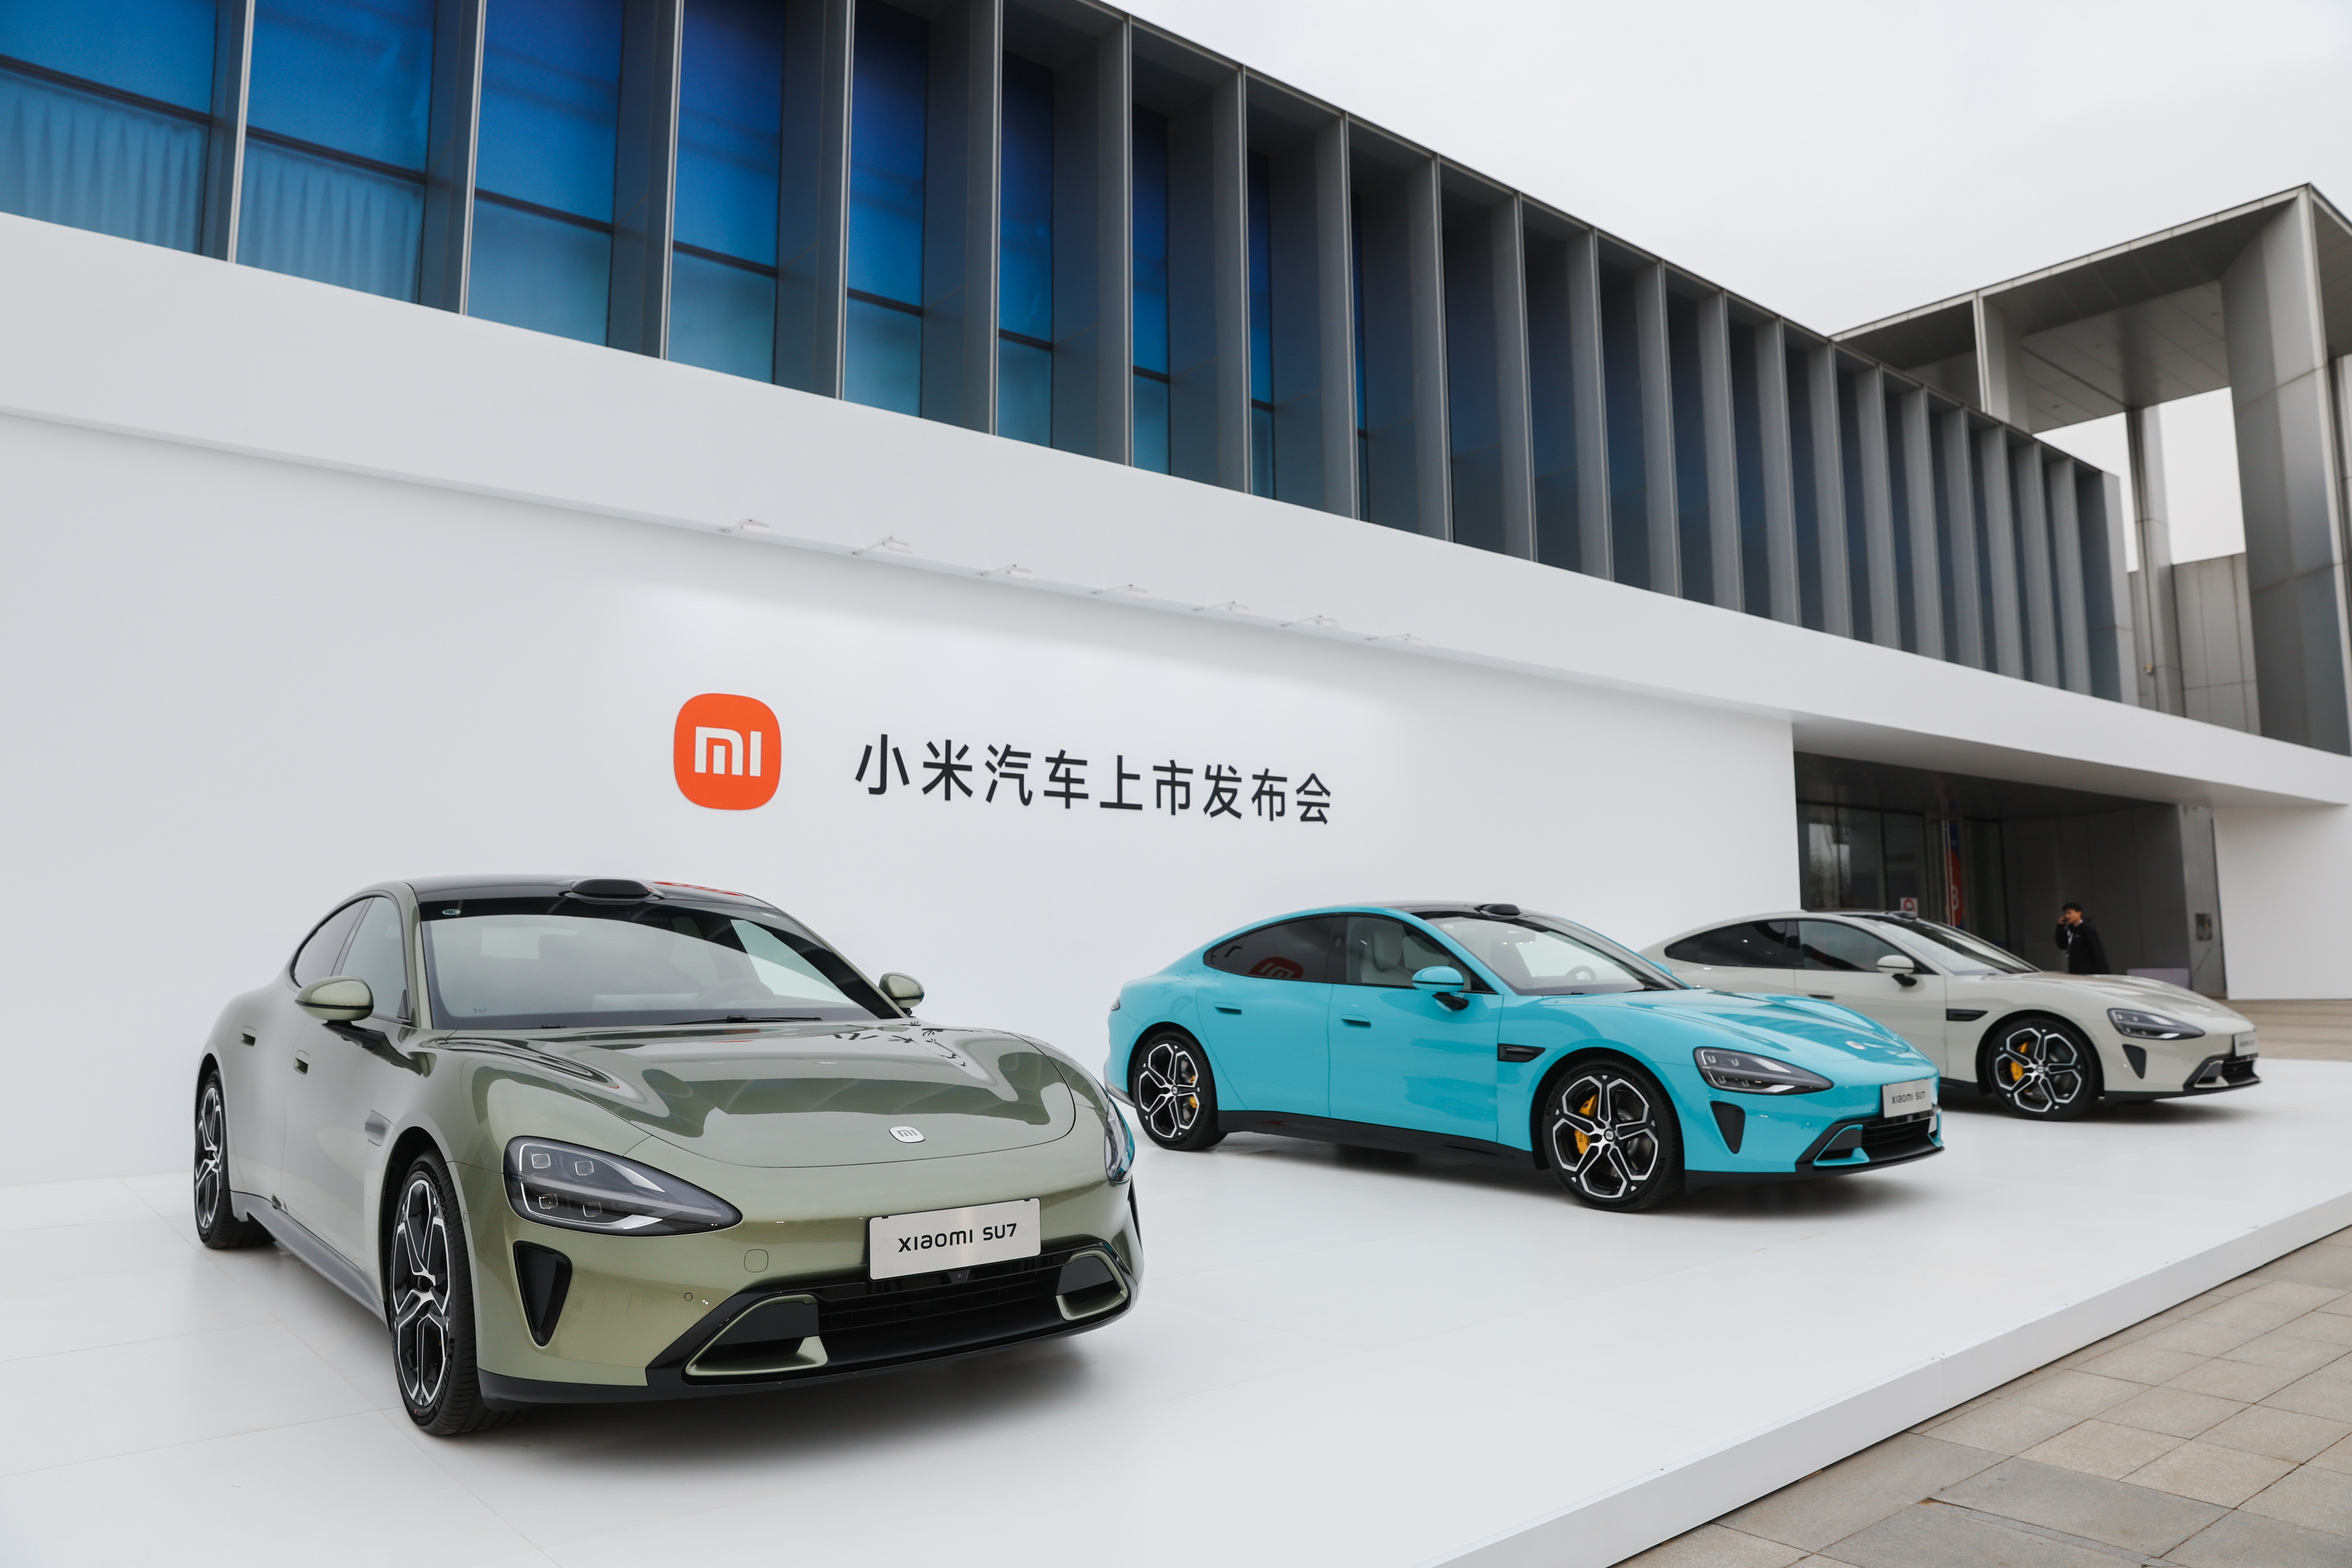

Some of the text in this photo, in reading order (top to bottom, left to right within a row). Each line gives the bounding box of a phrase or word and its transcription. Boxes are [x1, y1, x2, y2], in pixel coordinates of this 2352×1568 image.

[855, 734, 1331, 824] 小米汽车上市发布会
[983, 1223, 1017, 1240] SU7
[435, 1357, 451, 1412] MICHELIN
